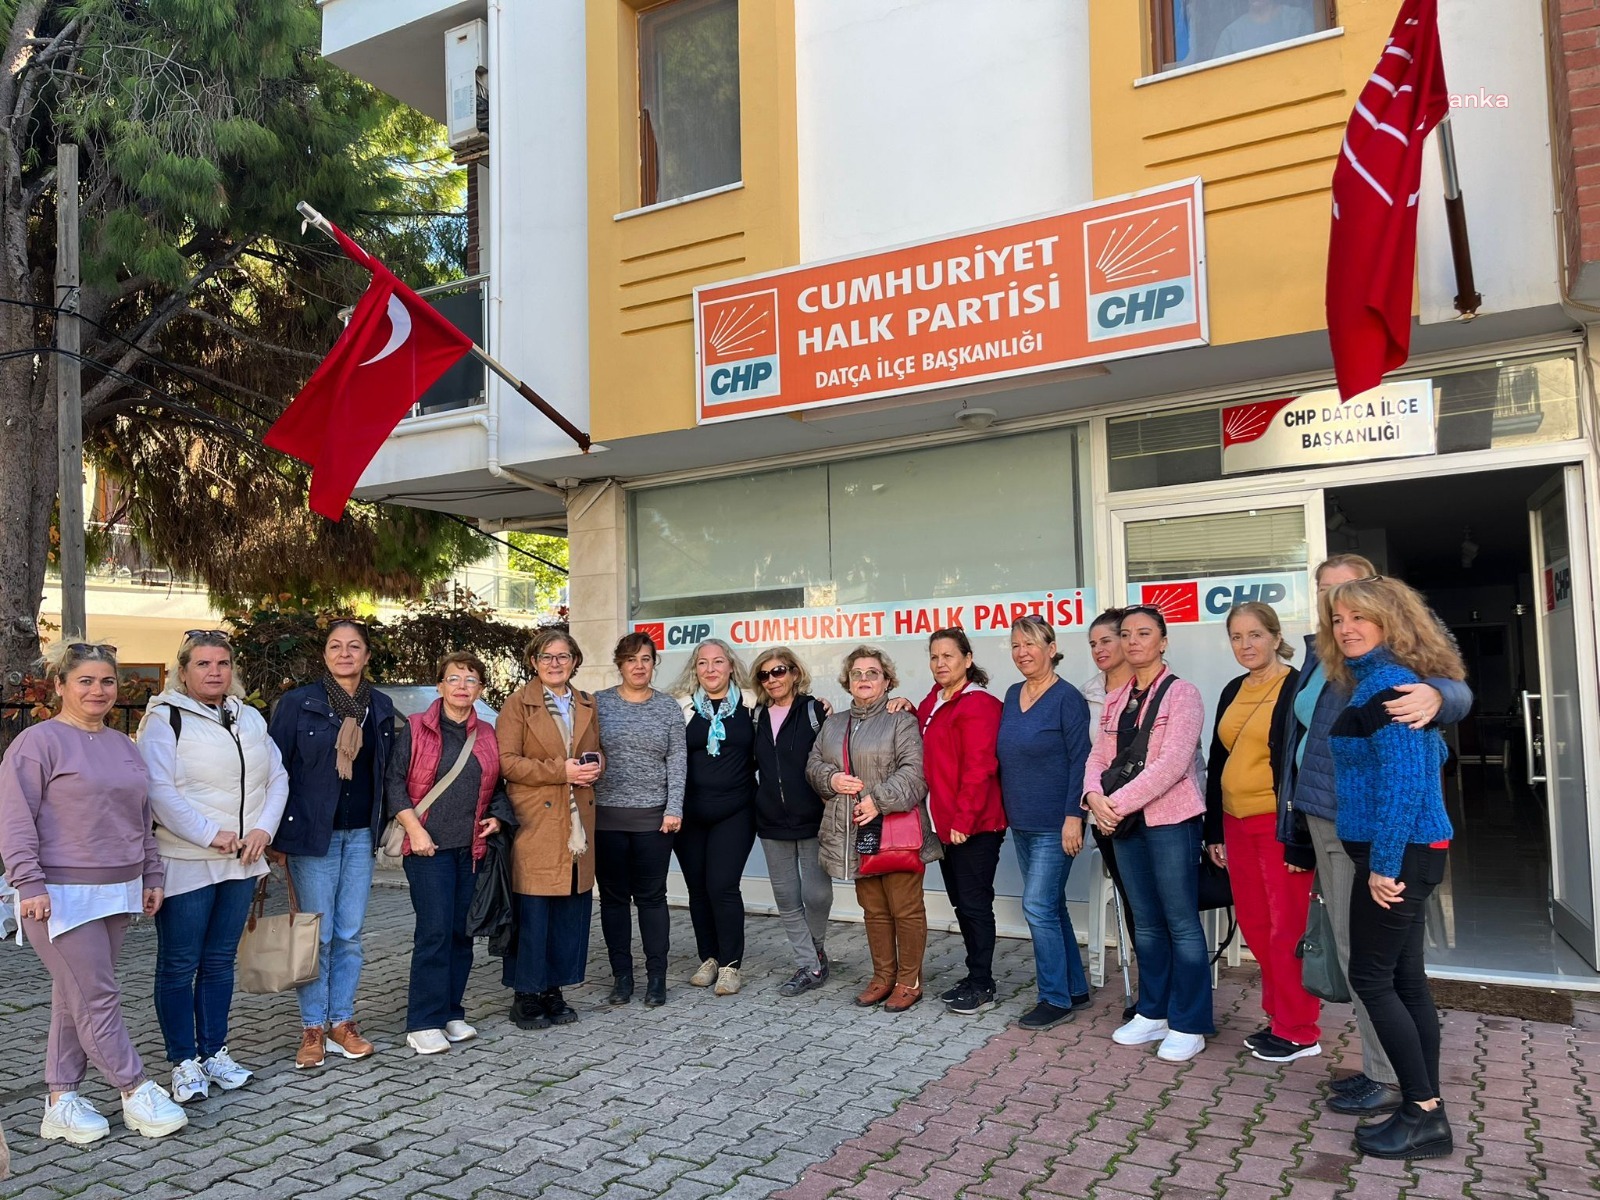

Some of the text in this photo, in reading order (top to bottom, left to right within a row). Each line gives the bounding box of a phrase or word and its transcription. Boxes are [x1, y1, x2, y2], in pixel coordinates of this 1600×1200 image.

[797, 235, 1058, 313] CUMHURİYET
[798, 273, 1060, 356] HALK PARTİSİ
[1097, 285, 1184, 328] CHP
[710, 361, 772, 396] CHP
[815, 330, 1042, 389] DATÇA İLÇE BAŞKANLIĞI
[1284, 396, 1419, 427] CHP DATÇA İLÇE
[1302, 421, 1400, 450] BAŞKANLIĞI
[730, 591, 1083, 643] CUMHURİYET HALK PARTİSİ
[1205, 583, 1286, 614] CHP
[667, 623, 710, 645] CHP
